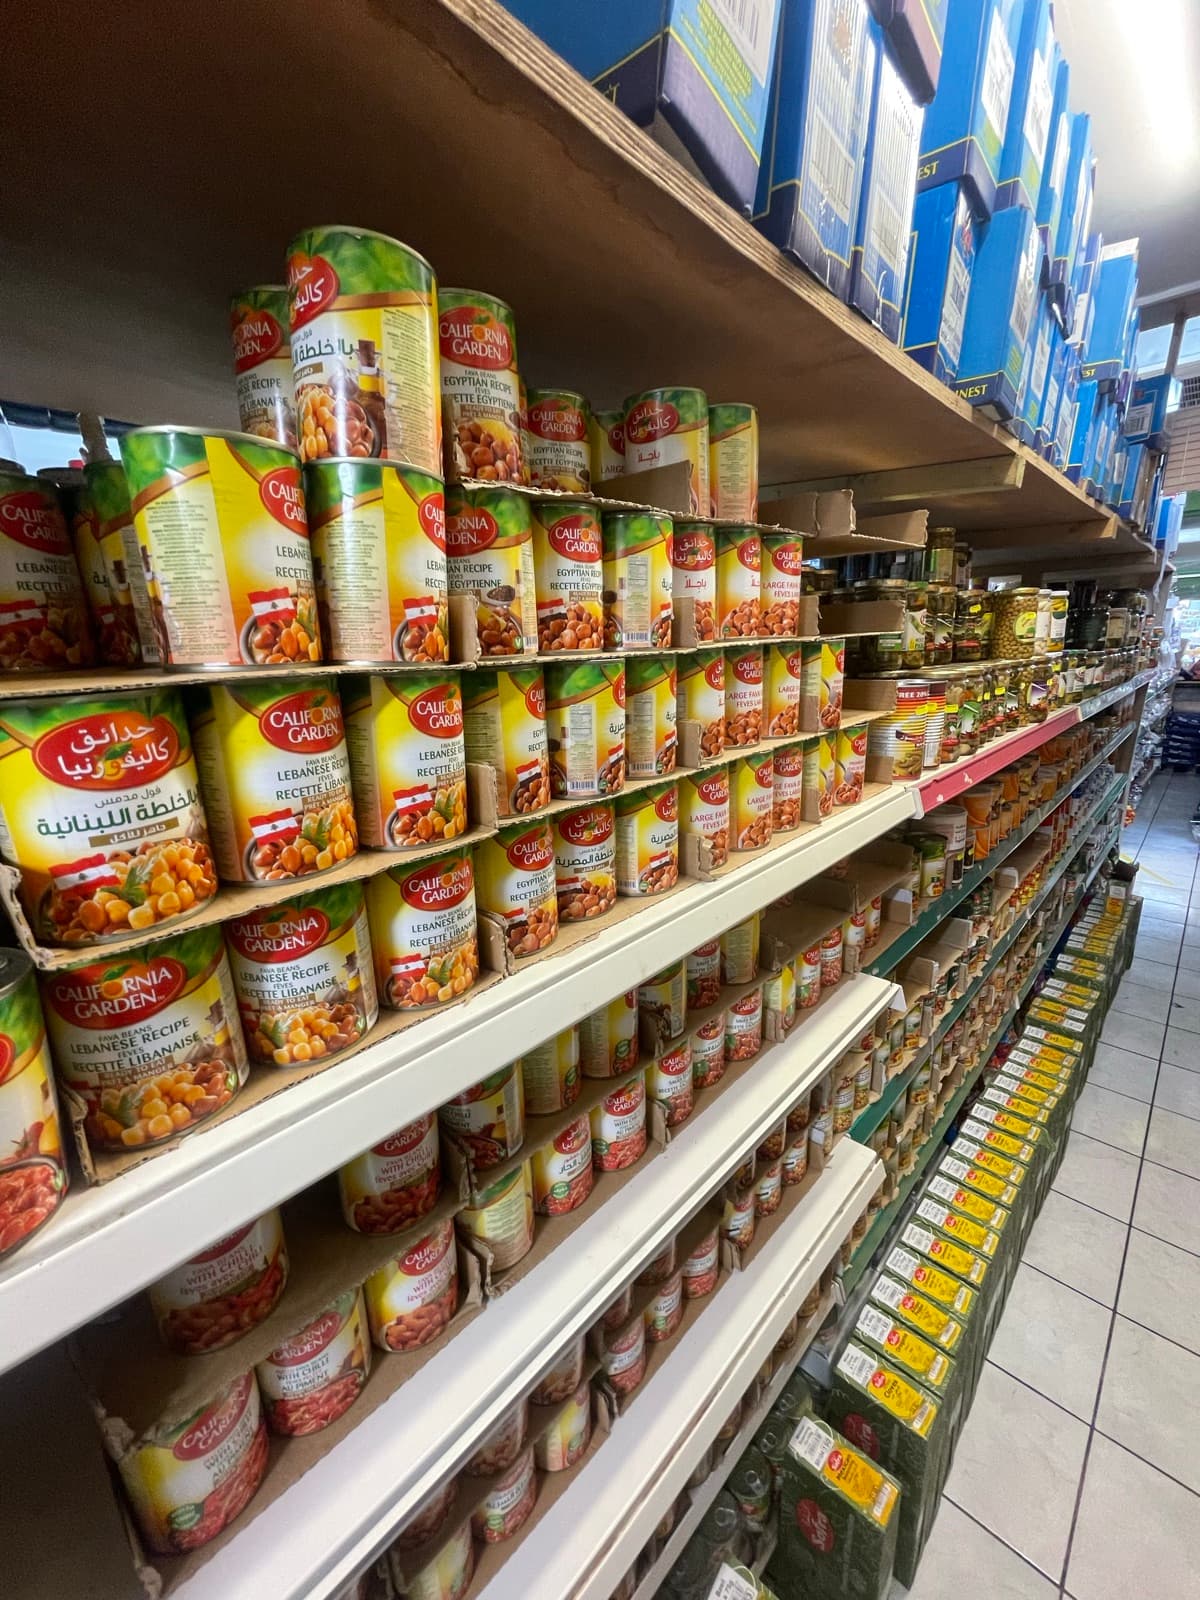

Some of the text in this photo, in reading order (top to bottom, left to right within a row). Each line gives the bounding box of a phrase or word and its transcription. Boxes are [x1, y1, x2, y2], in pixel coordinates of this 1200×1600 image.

[917, 161, 939, 181] EST
[440, 322, 508, 349] CALIFORNIA
[452, 339, 501, 361] GARDEN
[444, 376, 488, 388] EGYPTIAN
[454, 393, 474, 403] ETTE
[954, 384, 988, 401] INEST
[541, 421, 577, 435] GARDEN
[463, 563, 493, 574] RECIPE
[557, 568, 590, 577] EGYPTIAN
[450, 579, 502, 589] EGYPTIENNE
[550, 582, 580, 591] RECETTE
[70, 720, 155, 755] حدائق
[288, 723, 338, 743] GARDEN
[57, 737, 169, 781] كاليفورنيا
[419, 747, 457, 761] LEBANESE
[277, 763, 331, 781] LEBANESE
[417, 764, 451, 777] RECETTE
[141, 786, 162, 801] فول
[276, 783, 323, 800] RECETTE
[37, 807, 132, 839] اللبنانية
[690, 813, 713, 823] LARGE
[408, 864, 471, 893] CALIFORNIA
[516, 875, 547, 889] EGYPTIAN
[422, 882, 466, 904] GARDEN
[232, 916, 319, 938] CALIFORNIA
[411, 916, 455, 934] LEBANESE
[244, 934, 306, 952] GARDEN
[410, 933, 447, 948] RECETTE
[240, 963, 330, 984] LEBANESE RECIPE
[276, 963, 301, 973] BEANS
[55, 967, 172, 1002] CALIFORNIA
[281, 976, 338, 998] LIBANAISE
[75, 989, 157, 1018] GARDEN
[71, 1017, 191, 1055] LEBANESE RECIPE
[121, 1025, 153, 1038] BEANS
[72, 1031, 200, 1073] RECETTE LIBANAISE
